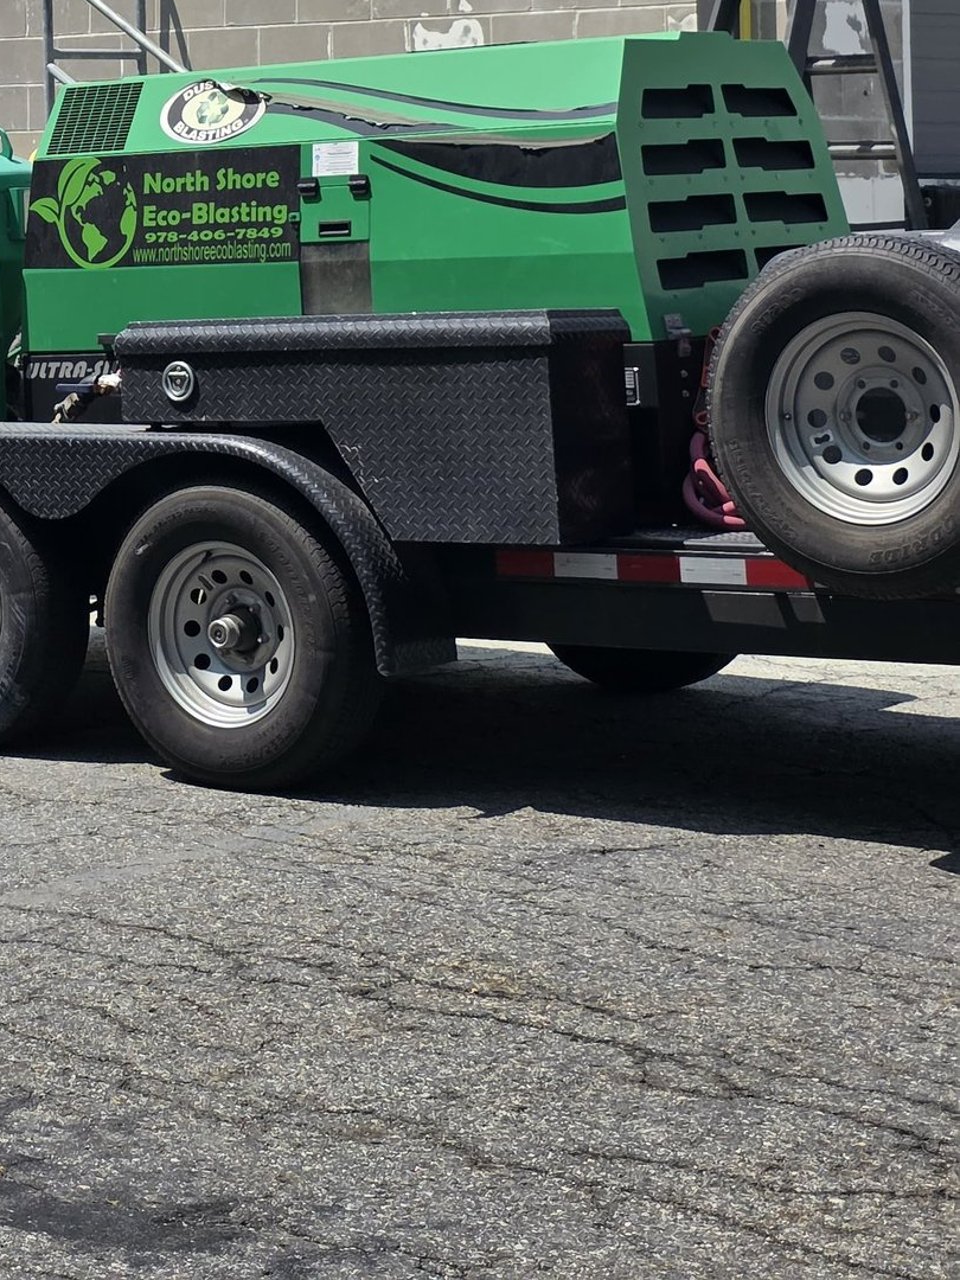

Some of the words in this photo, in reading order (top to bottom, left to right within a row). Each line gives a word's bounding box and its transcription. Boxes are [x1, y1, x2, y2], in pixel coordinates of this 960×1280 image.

[173, 119, 244, 141] BLASTING
[143, 170, 210, 194] North
[216, 168, 280, 191] Shore
[143, 200, 288, 227] Eco-Blasting
[145, 227, 283, 243] 978-406-7849
[133, 240, 291, 262] www.northshoreecoblasting.com
